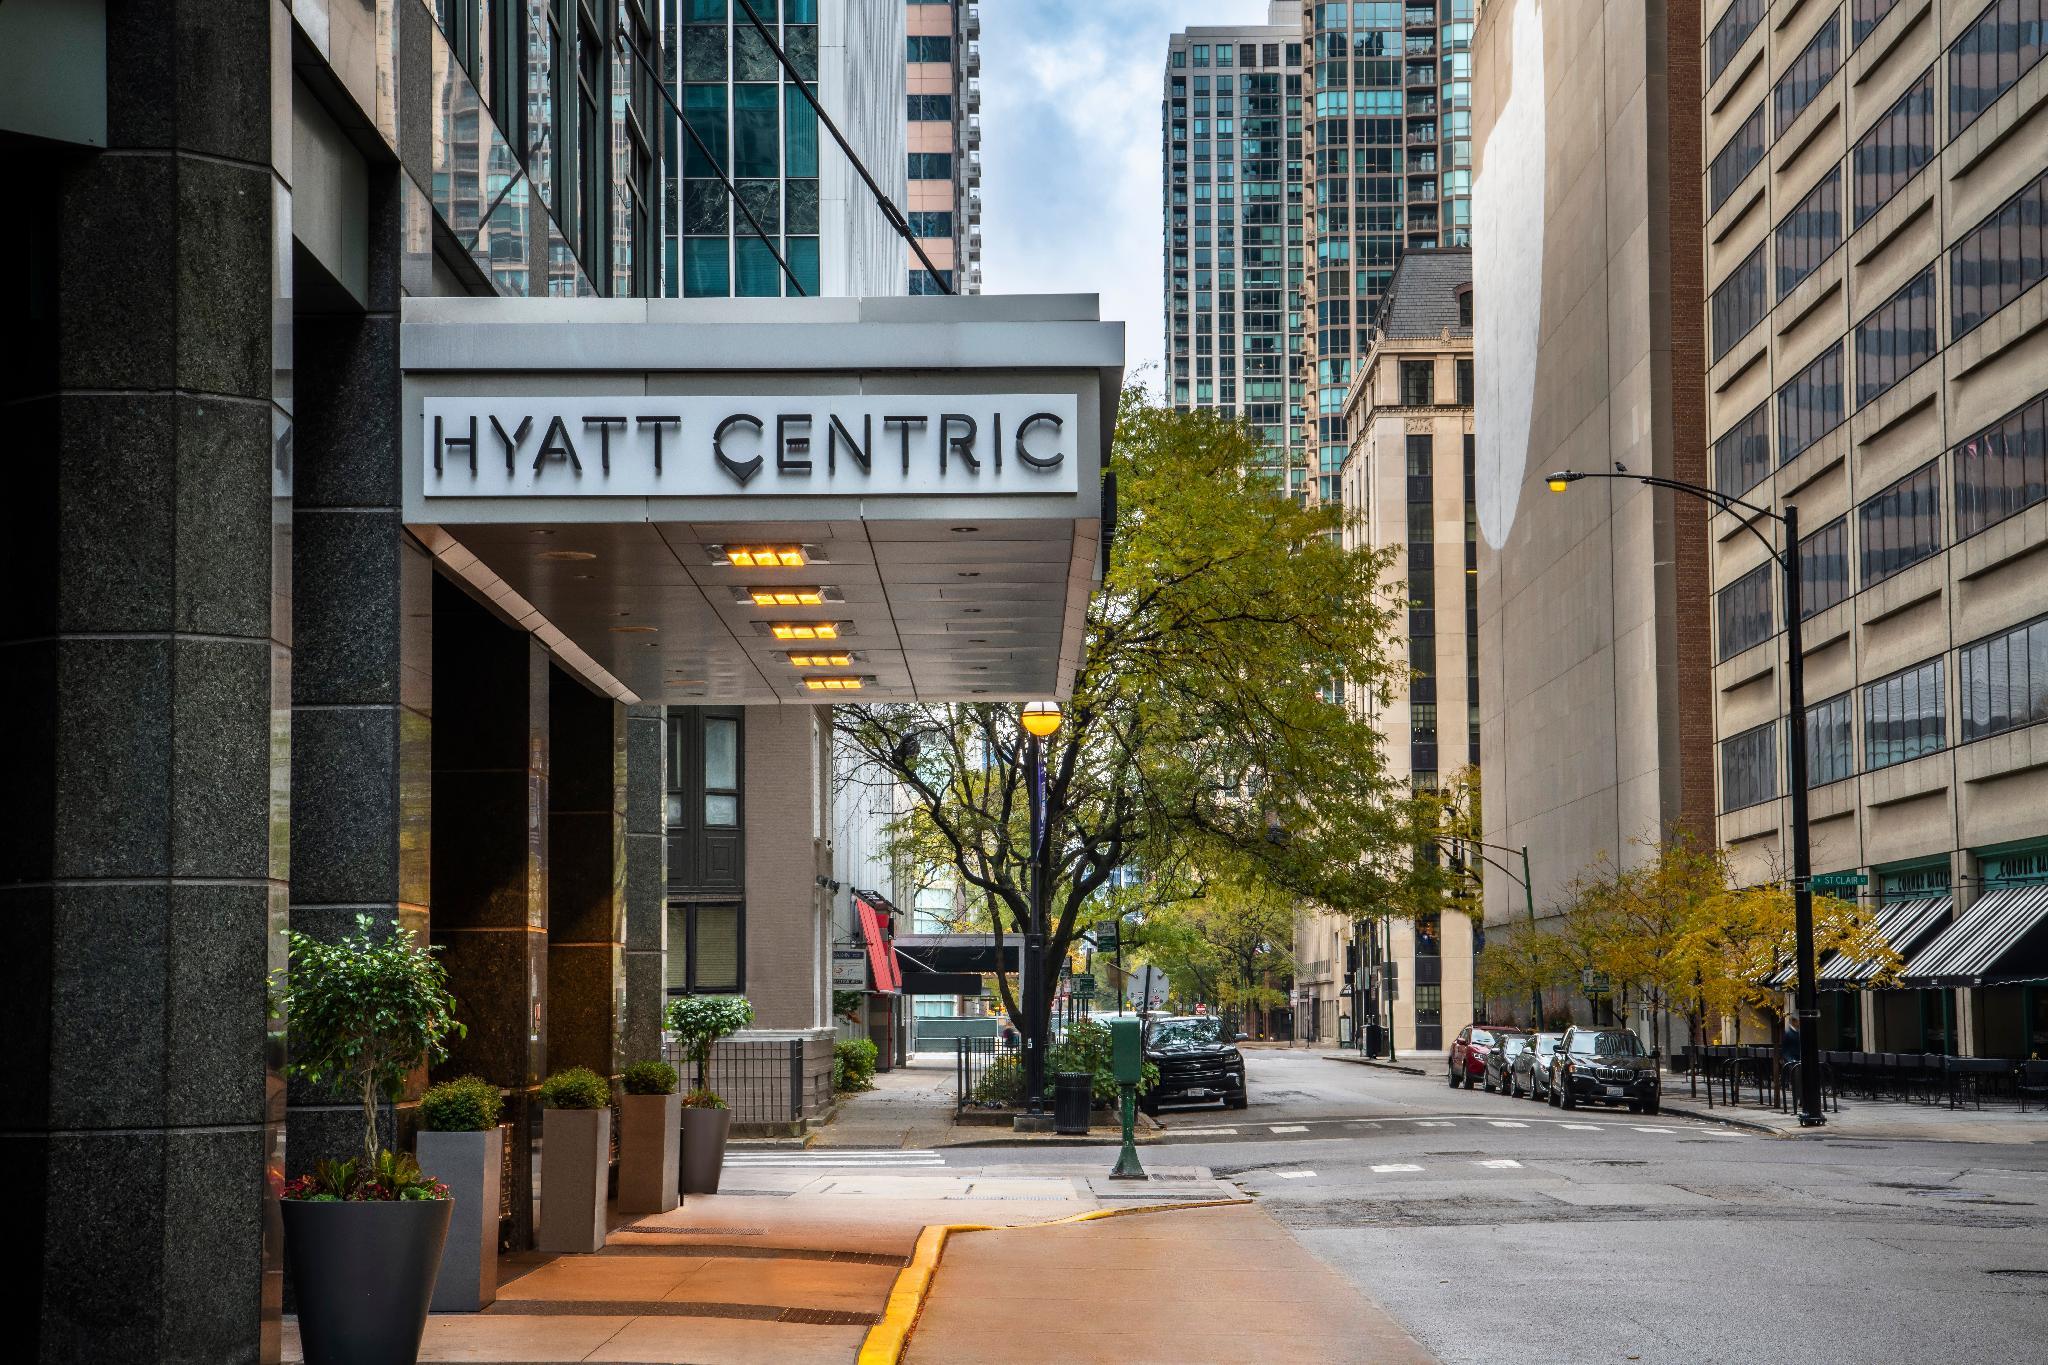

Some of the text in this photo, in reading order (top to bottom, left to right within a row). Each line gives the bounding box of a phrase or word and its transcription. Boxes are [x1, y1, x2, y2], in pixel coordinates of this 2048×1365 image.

[433, 412, 1065, 481] HYATT CENTRIC
[1999, 857, 2033, 877] CORNER
[1824, 876, 1834, 885] ST
[1836, 876, 1858, 885] CLAIR
[1898, 873, 1925, 891] CORNER
